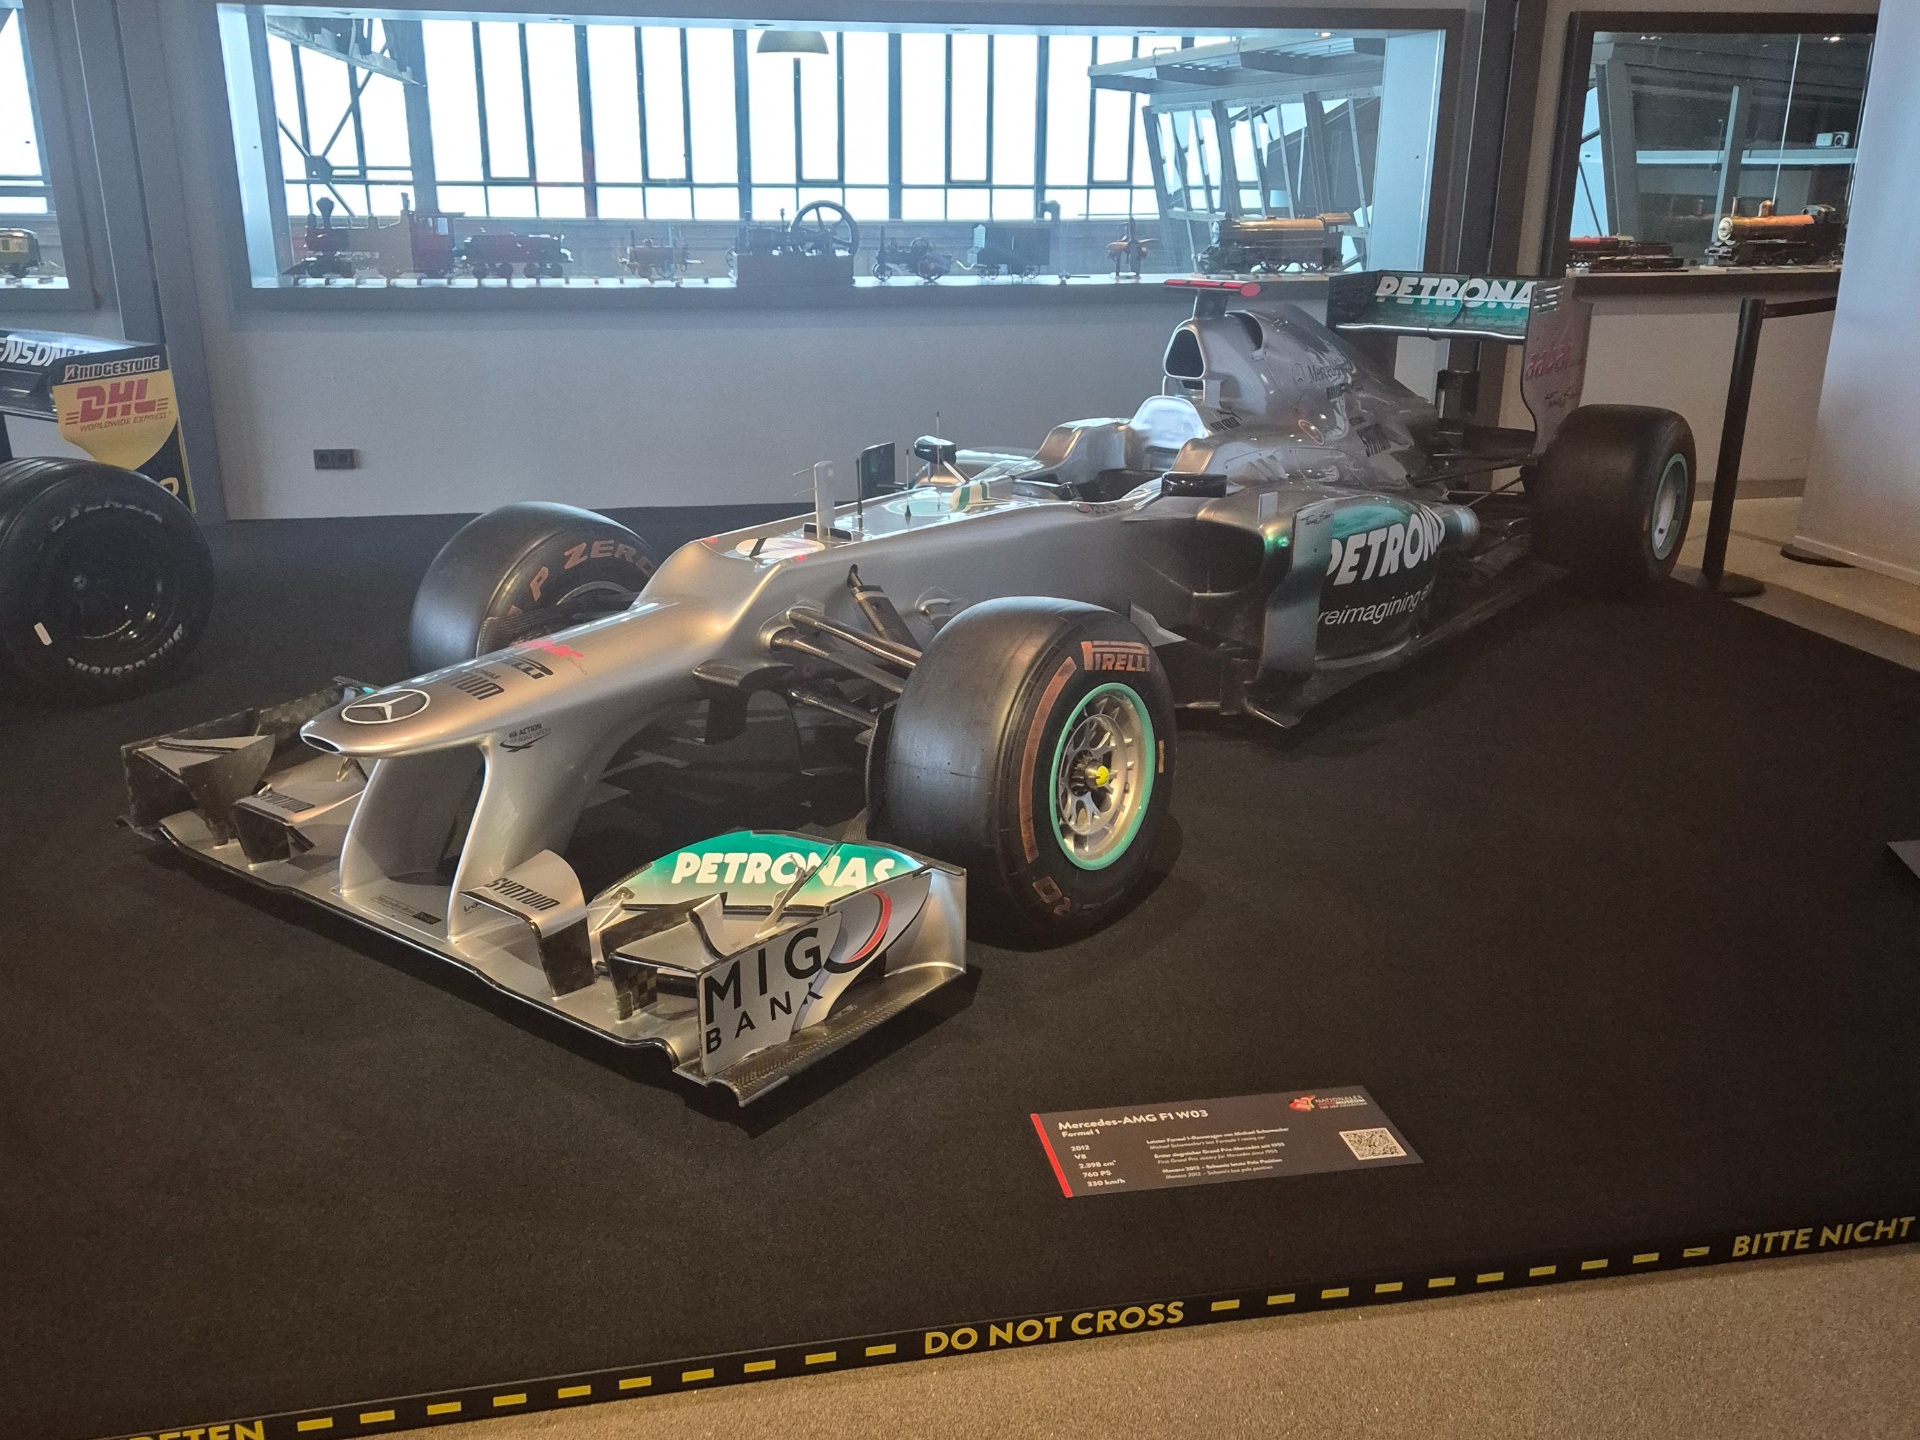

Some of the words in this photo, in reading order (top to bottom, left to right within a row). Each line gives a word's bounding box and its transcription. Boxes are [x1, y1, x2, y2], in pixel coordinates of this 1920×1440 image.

[1375, 275, 1536, 309] PETRONA
[63, 355, 160, 383] BRIDGESTONE
[76, 378, 157, 424] DHL
[80, 417, 131, 433] WORLDWIDE
[133, 412, 167, 425] EXPRESS
[564, 539, 657, 578] ZERO
[1317, 590, 1422, 626] reimagining
[1081, 640, 1150, 672] PIRELLI
[671, 852, 896, 890] PETRONAS
[704, 927, 823, 1026] MIG
[1057, 1114, 1157, 1130] Mercedes-AMG
[1159, 1112, 1174, 1121] F1
[1176, 1109, 1208, 1119] W03
[1062, 1129, 1094, 1137] Formel
[1732, 1228, 1813, 1257] BITTE
[1819, 1216, 1916, 1247] NICHT
[924, 1328, 979, 1354] DO
[990, 1316, 1063, 1346] NOT
[1071, 1301, 1184, 1335] CROSS
